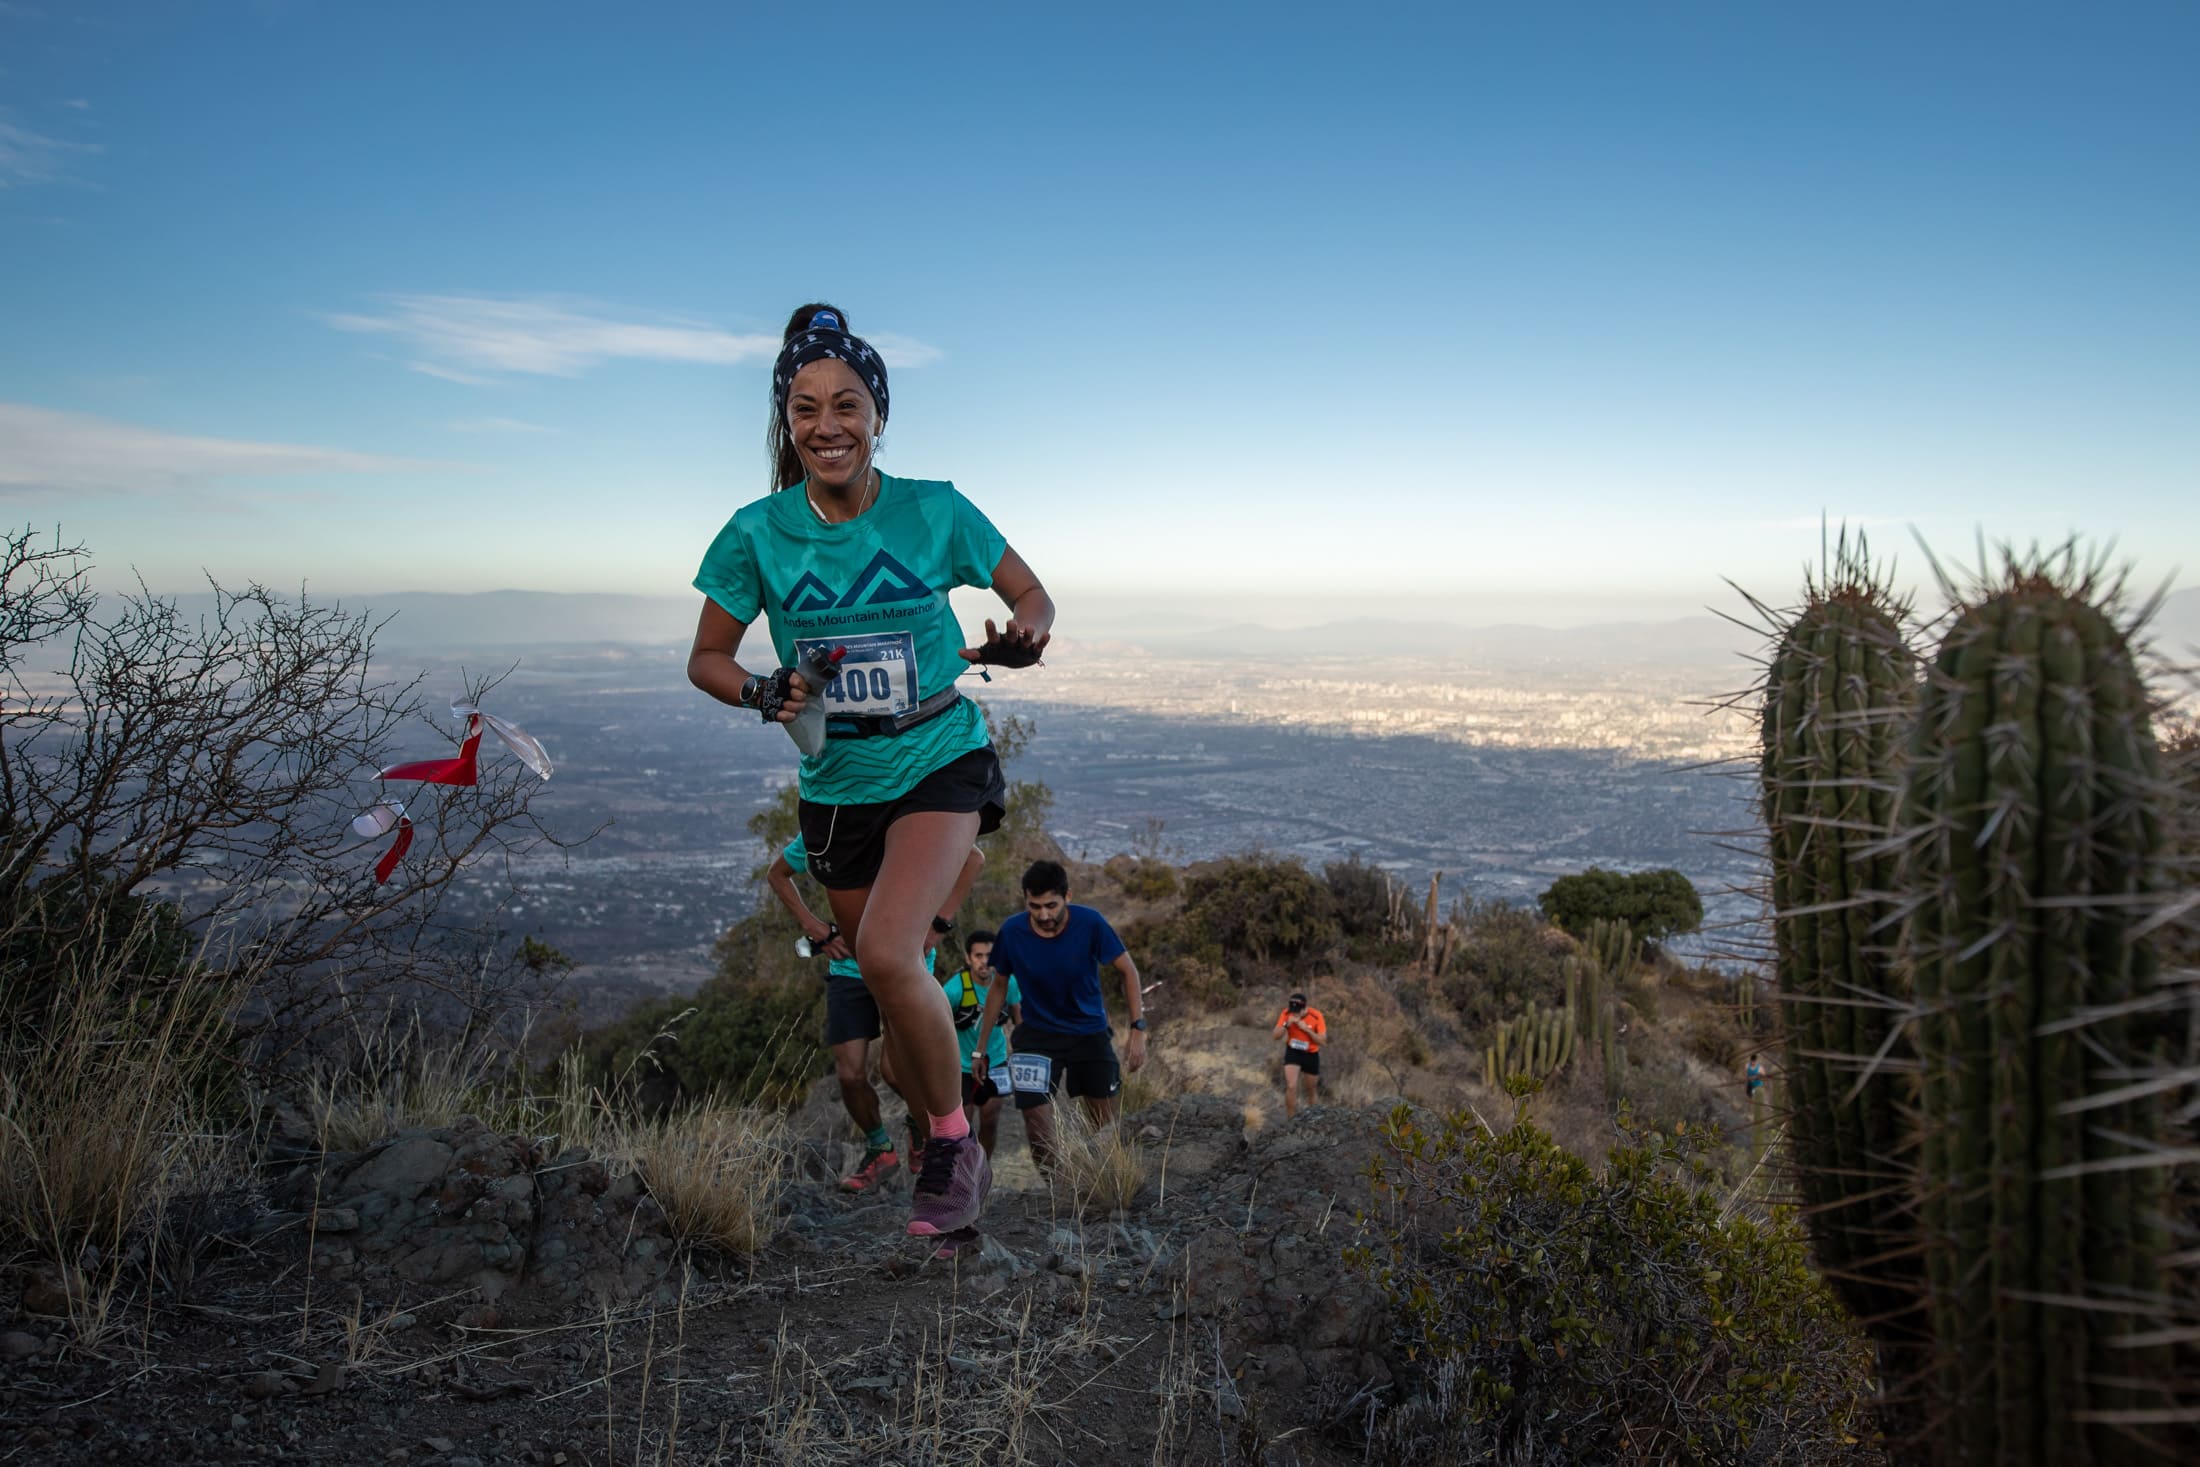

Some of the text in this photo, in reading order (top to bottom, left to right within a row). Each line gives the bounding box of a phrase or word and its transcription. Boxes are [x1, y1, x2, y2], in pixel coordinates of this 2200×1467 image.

[784, 602, 935, 628] Andes Mountain Marathon
[880, 648, 904, 661] 21K
[825, 667, 891, 703] 400
[1015, 1067, 1039, 1082] 361
